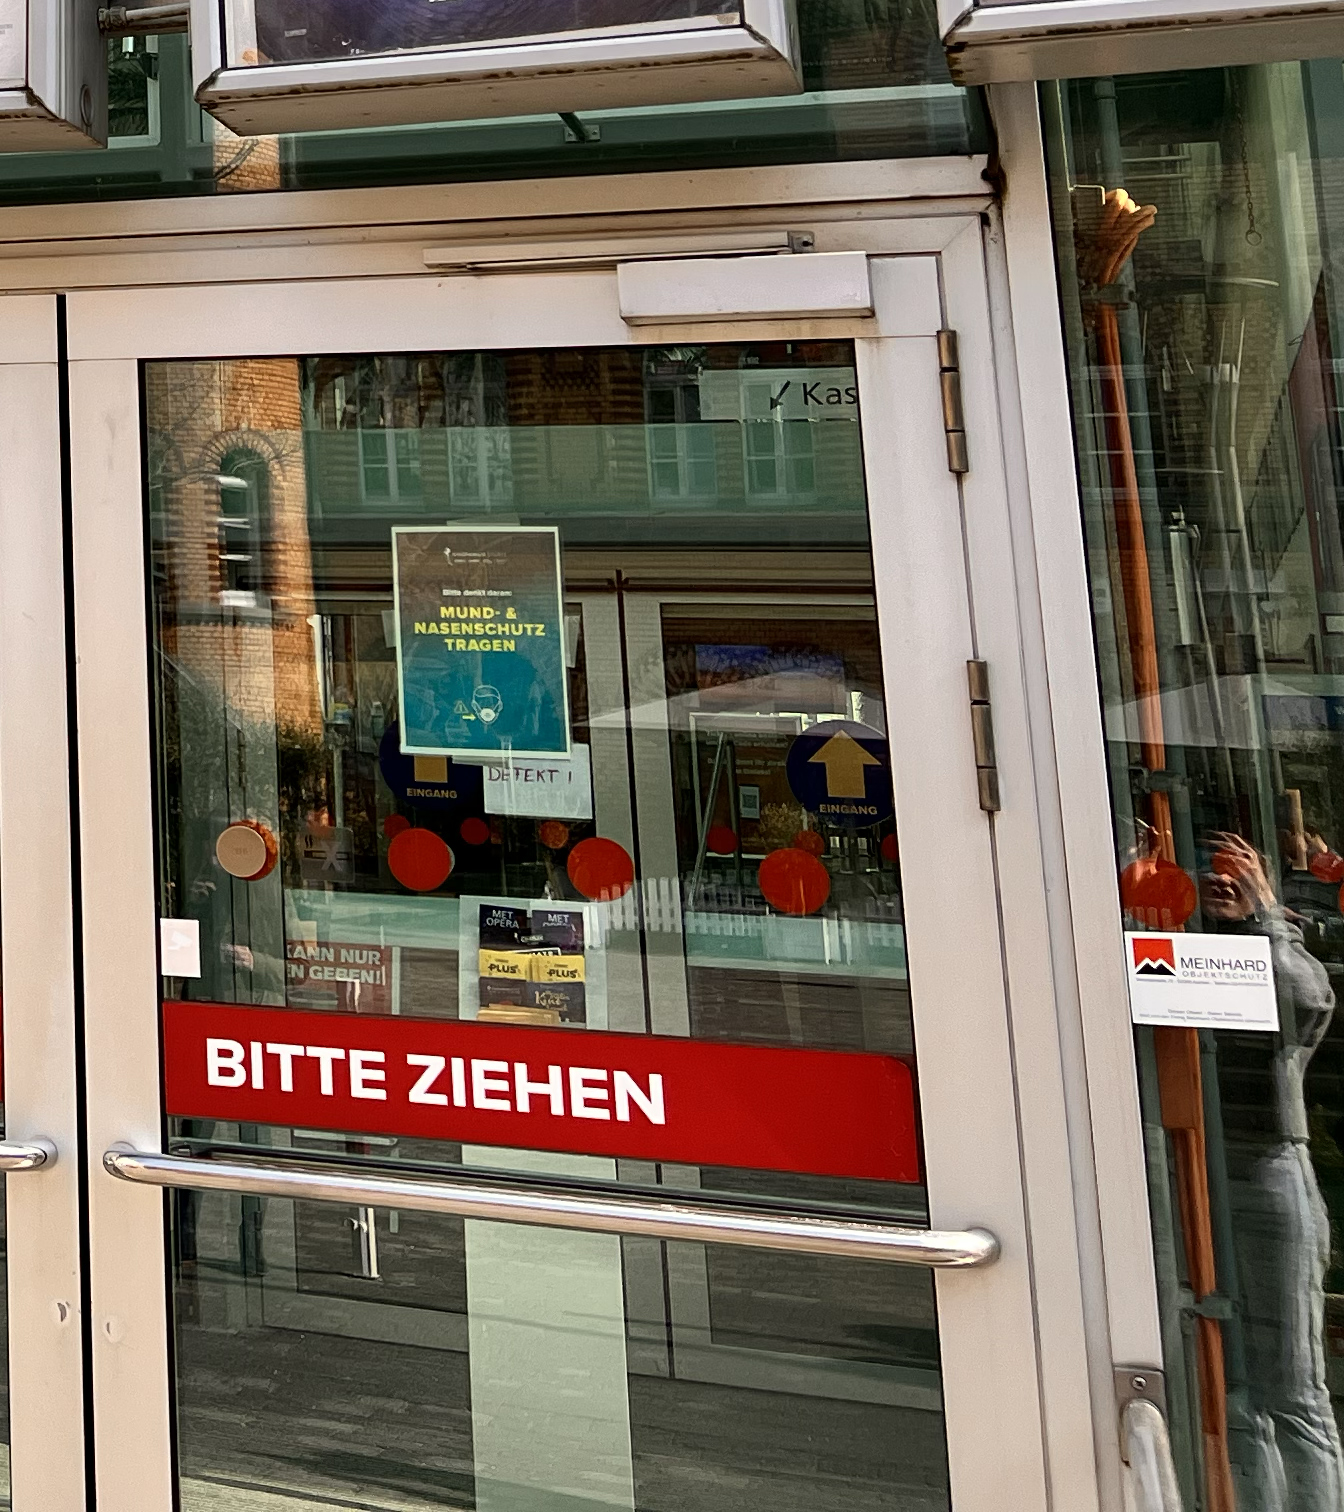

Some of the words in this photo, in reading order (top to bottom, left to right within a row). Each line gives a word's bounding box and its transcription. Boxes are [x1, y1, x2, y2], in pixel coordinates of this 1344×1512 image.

[440, 606, 501, 620] MUND-
[506, 607, 517, 620] &
[414, 622, 545, 637] NASENSCHUTZ
[444, 638, 516, 652] TRAGEN
[406, 787, 457, 799] EINGANG
[819, 803, 878, 816] EINGANG
[492, 909, 514, 920] MET
[547, 913, 570, 924] MET
[340, 948, 381, 965] NUR
[1180, 957, 1267, 972] MEINHARD
[309, 965, 381, 985] GEBEN!
[1182, 970, 1269, 981] OBJEKTSCHUTZ
[204, 1036, 388, 1101] BITTE
[406, 1051, 667, 1126] ZIEHEN
